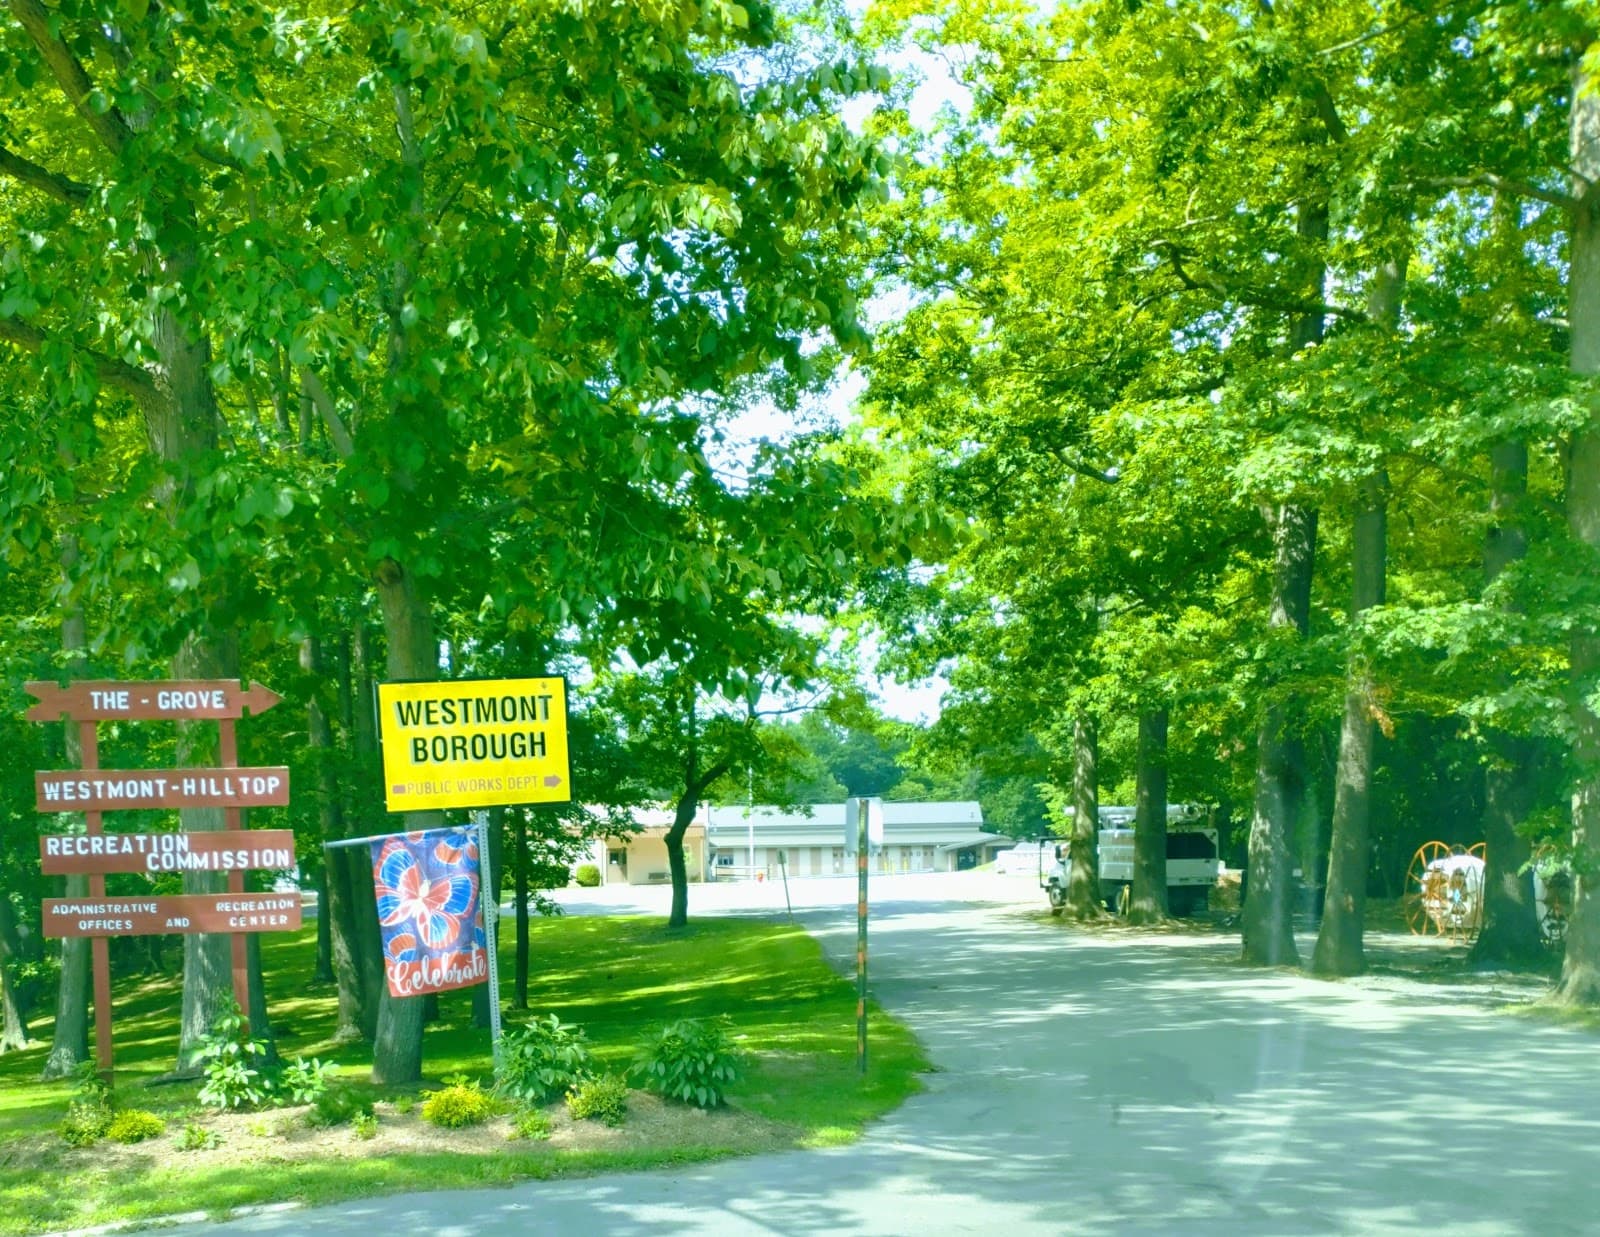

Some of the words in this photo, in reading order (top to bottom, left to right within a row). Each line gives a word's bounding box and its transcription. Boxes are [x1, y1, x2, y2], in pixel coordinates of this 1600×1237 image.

[90, 691, 129, 710] THE
[157, 690, 225, 709] GROVE
[396, 694, 553, 727] WESTMONT
[411, 731, 547, 764] BOROUGH
[407, 780, 452, 795] PUBLIC
[457, 777, 503, 792] WORKS
[508, 775, 539, 790] DEPT
[47, 834, 189, 856] RECREATION
[146, 849, 289, 871] COMMISSION
[52, 903, 157, 915] ADMINISTRATIVE
[216, 899, 294, 912] RECREATION
[79, 919, 132, 930] OFFICES
[166, 918, 190, 928] AND
[229, 915, 288, 927] CENTER
[387, 947, 487, 994] Celebrate
